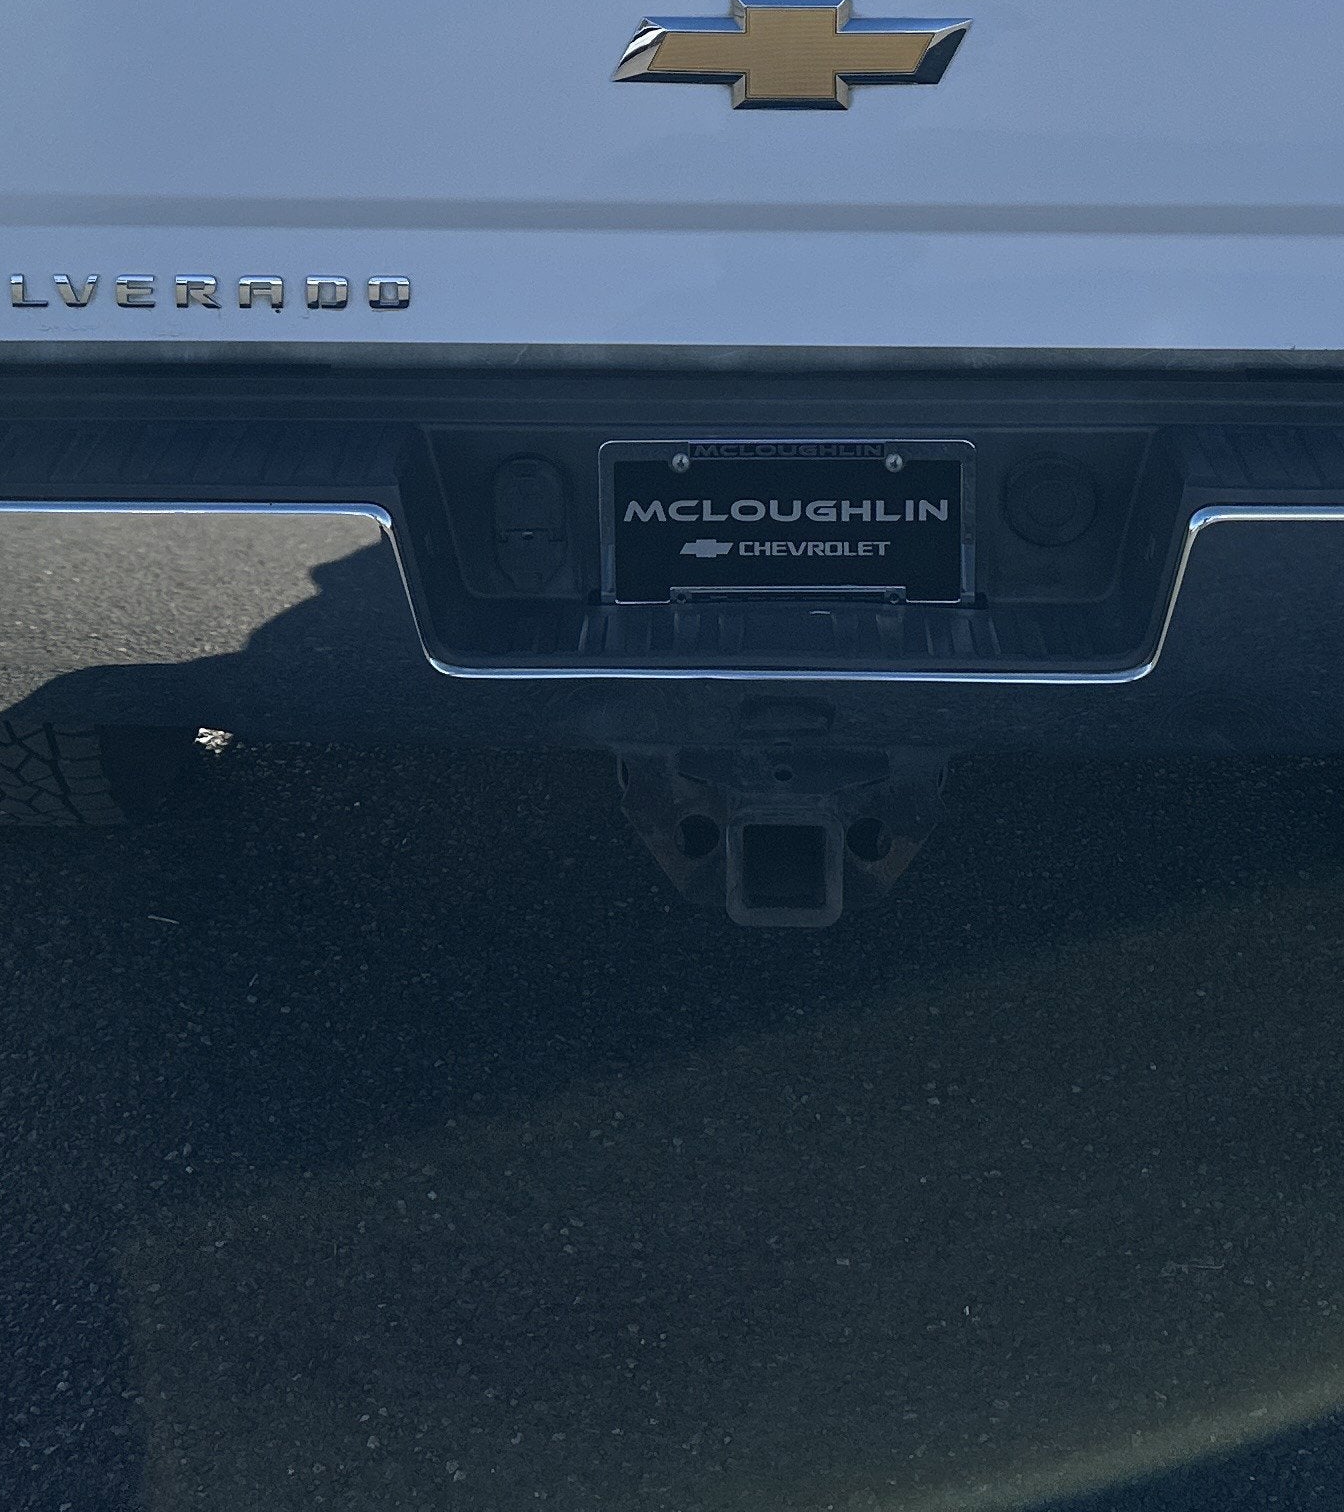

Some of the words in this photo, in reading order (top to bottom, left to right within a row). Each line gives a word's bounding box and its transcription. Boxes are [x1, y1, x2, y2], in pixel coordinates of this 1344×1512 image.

[693, 444, 882, 457] MCLOUGHLIN
[623, 499, 949, 522] MCLOUGHLIN
[739, 541, 891, 556] CHEVROLET
